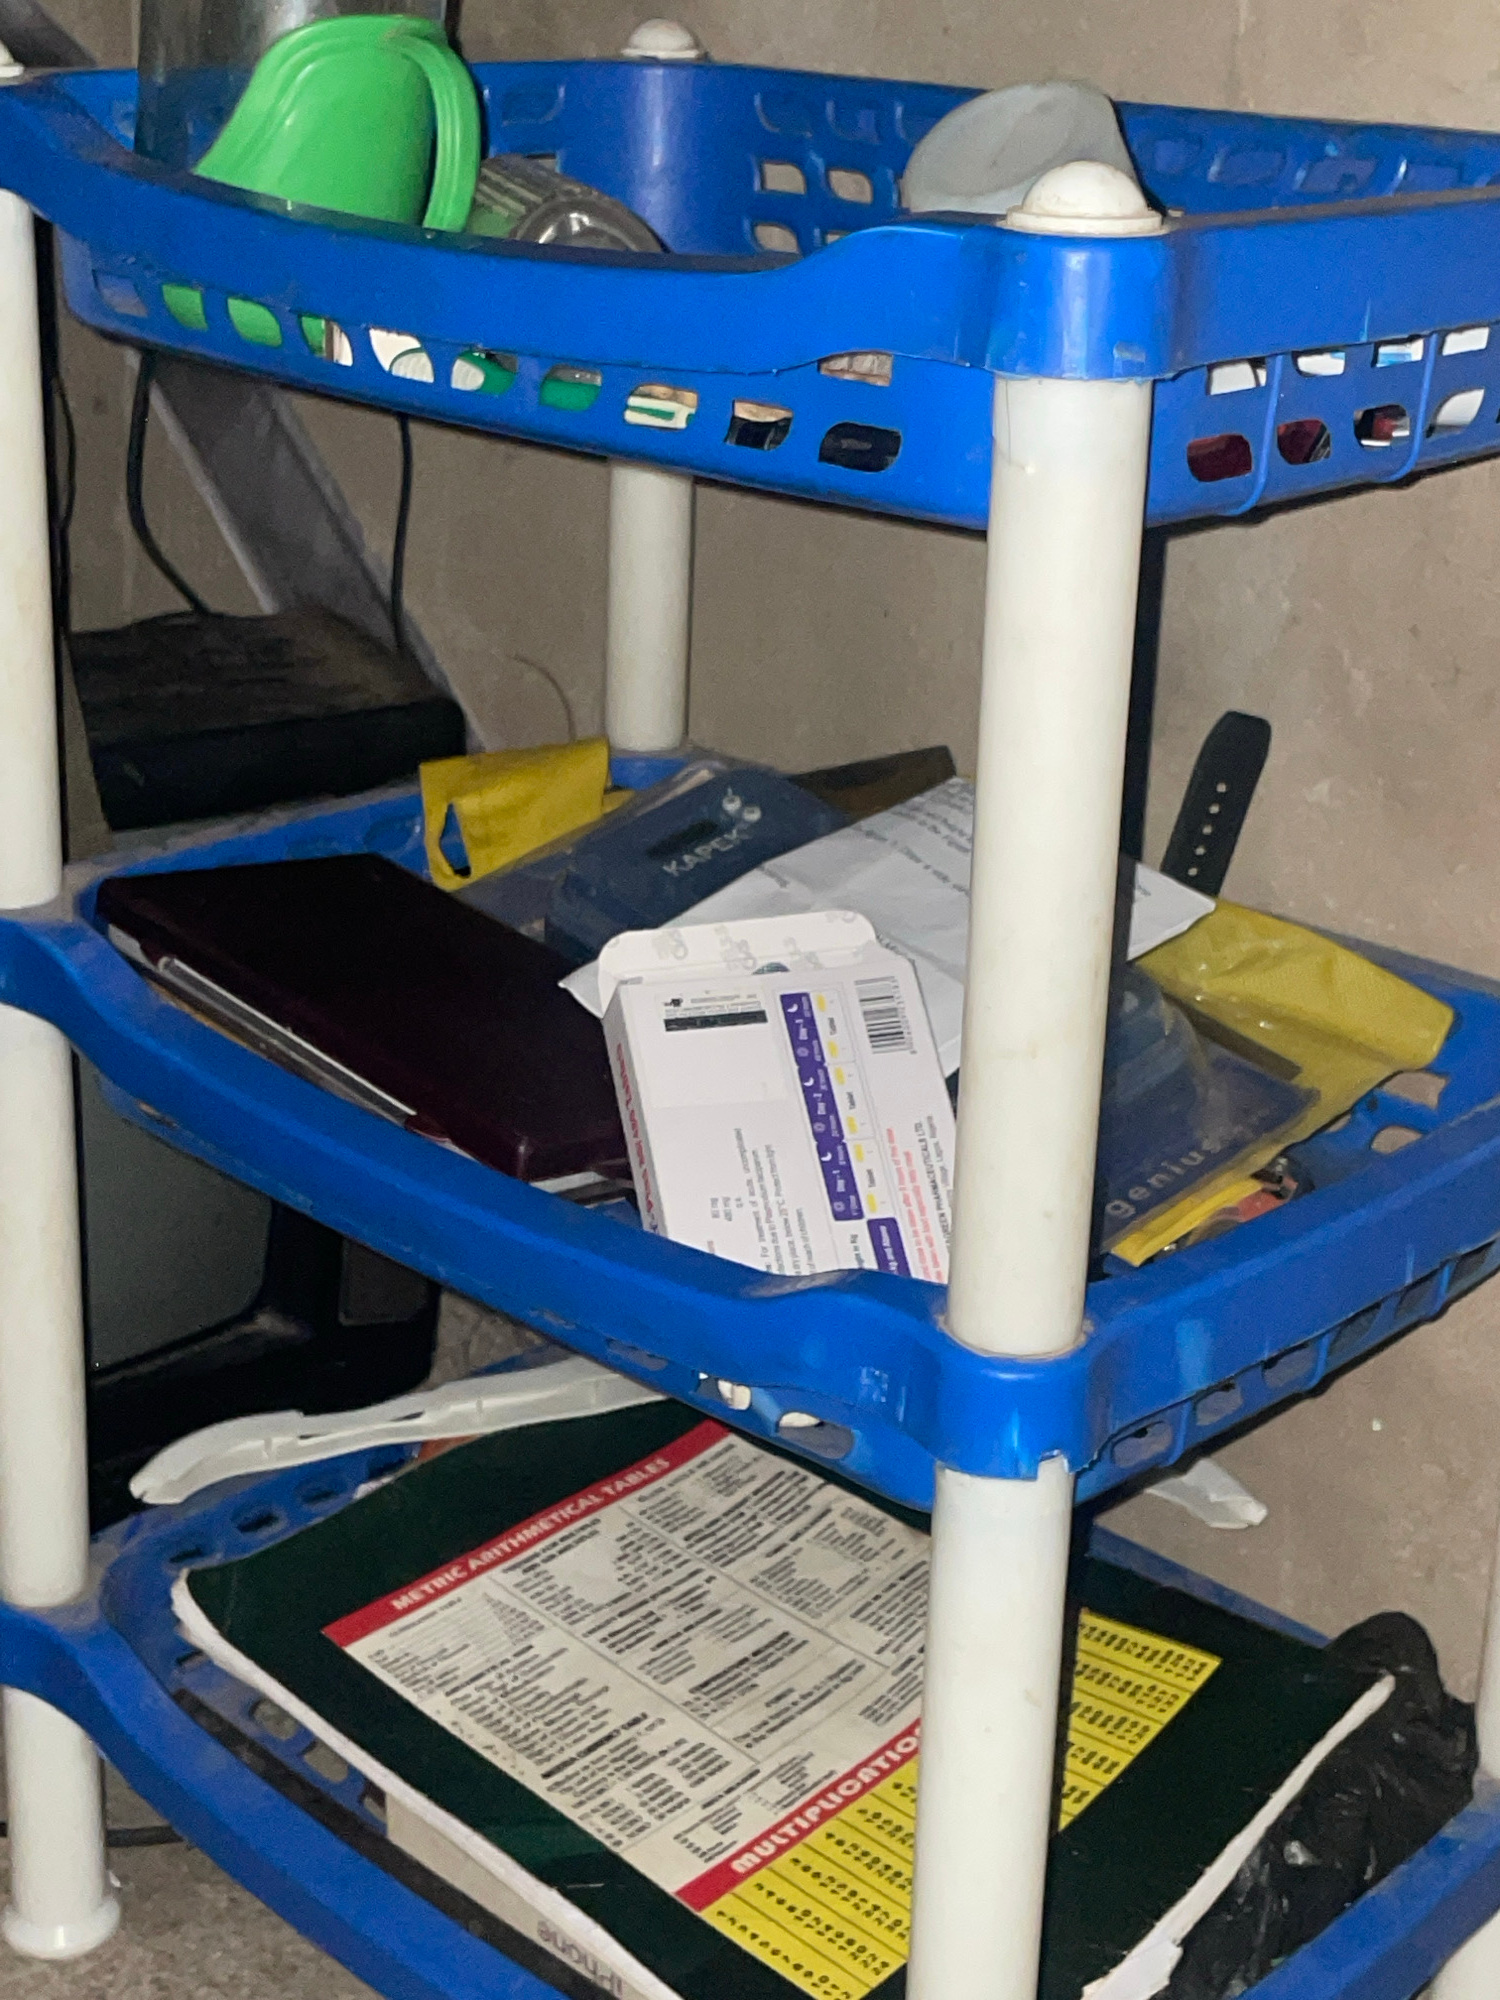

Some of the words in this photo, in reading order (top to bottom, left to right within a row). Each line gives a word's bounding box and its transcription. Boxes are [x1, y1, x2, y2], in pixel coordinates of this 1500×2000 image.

[391, 1564, 468, 1611] METRIC
[468, 1493, 605, 1571] ARITHMETICAL
[602, 1457, 671, 1497] TABLES
